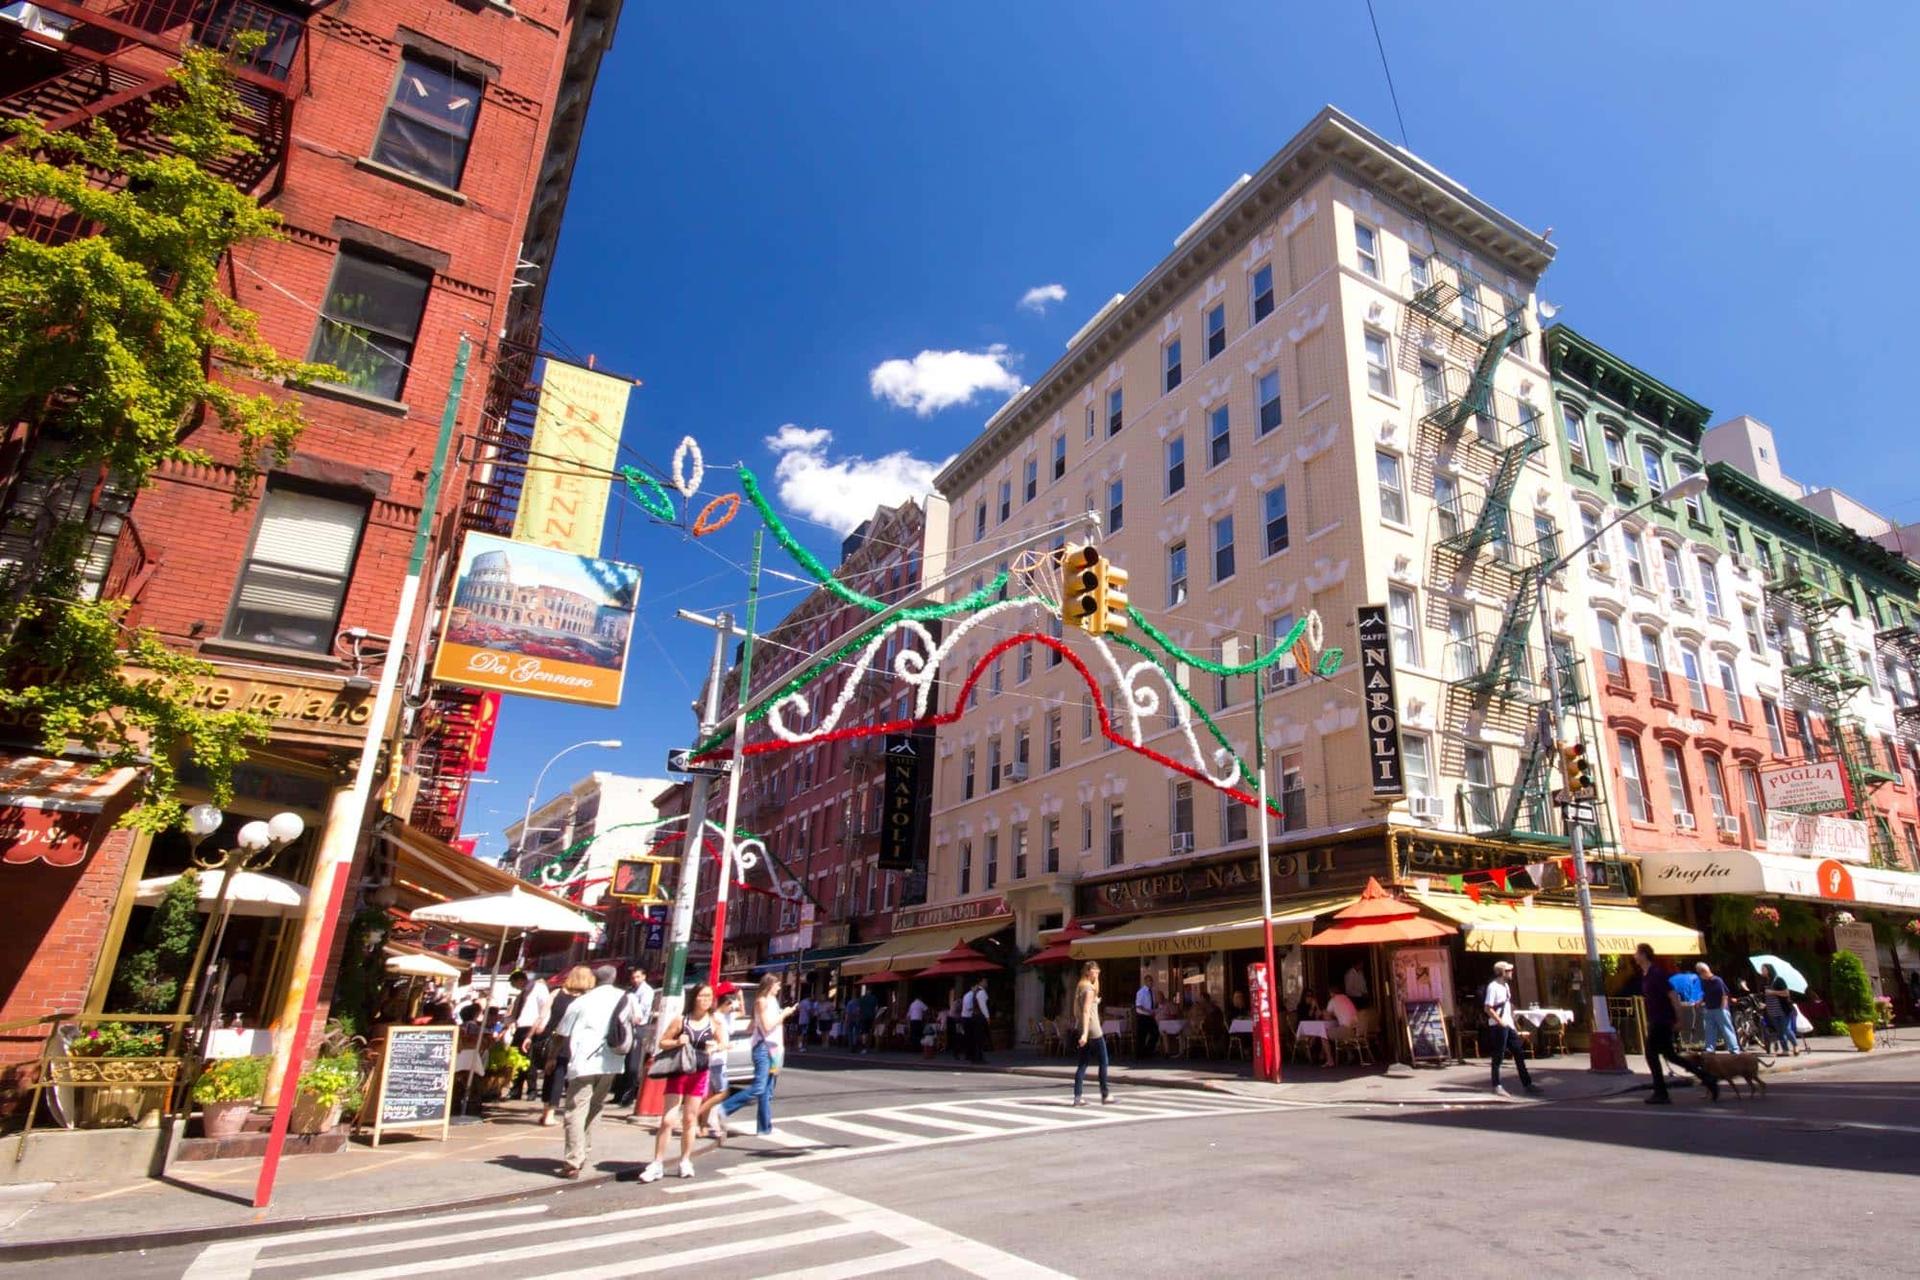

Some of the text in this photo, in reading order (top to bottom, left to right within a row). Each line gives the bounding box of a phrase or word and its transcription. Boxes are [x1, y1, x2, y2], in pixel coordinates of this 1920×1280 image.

[467, 652, 593, 688] Da Gennaro
[1364, 648, 1396, 780] NAPOLI
[1769, 768, 1834, 789] PUGLIA
[892, 766, 912, 858] NAPOLI
[1658, 862, 1732, 883] Puglia
[1173, 935, 1212, 951] NAPOLI
